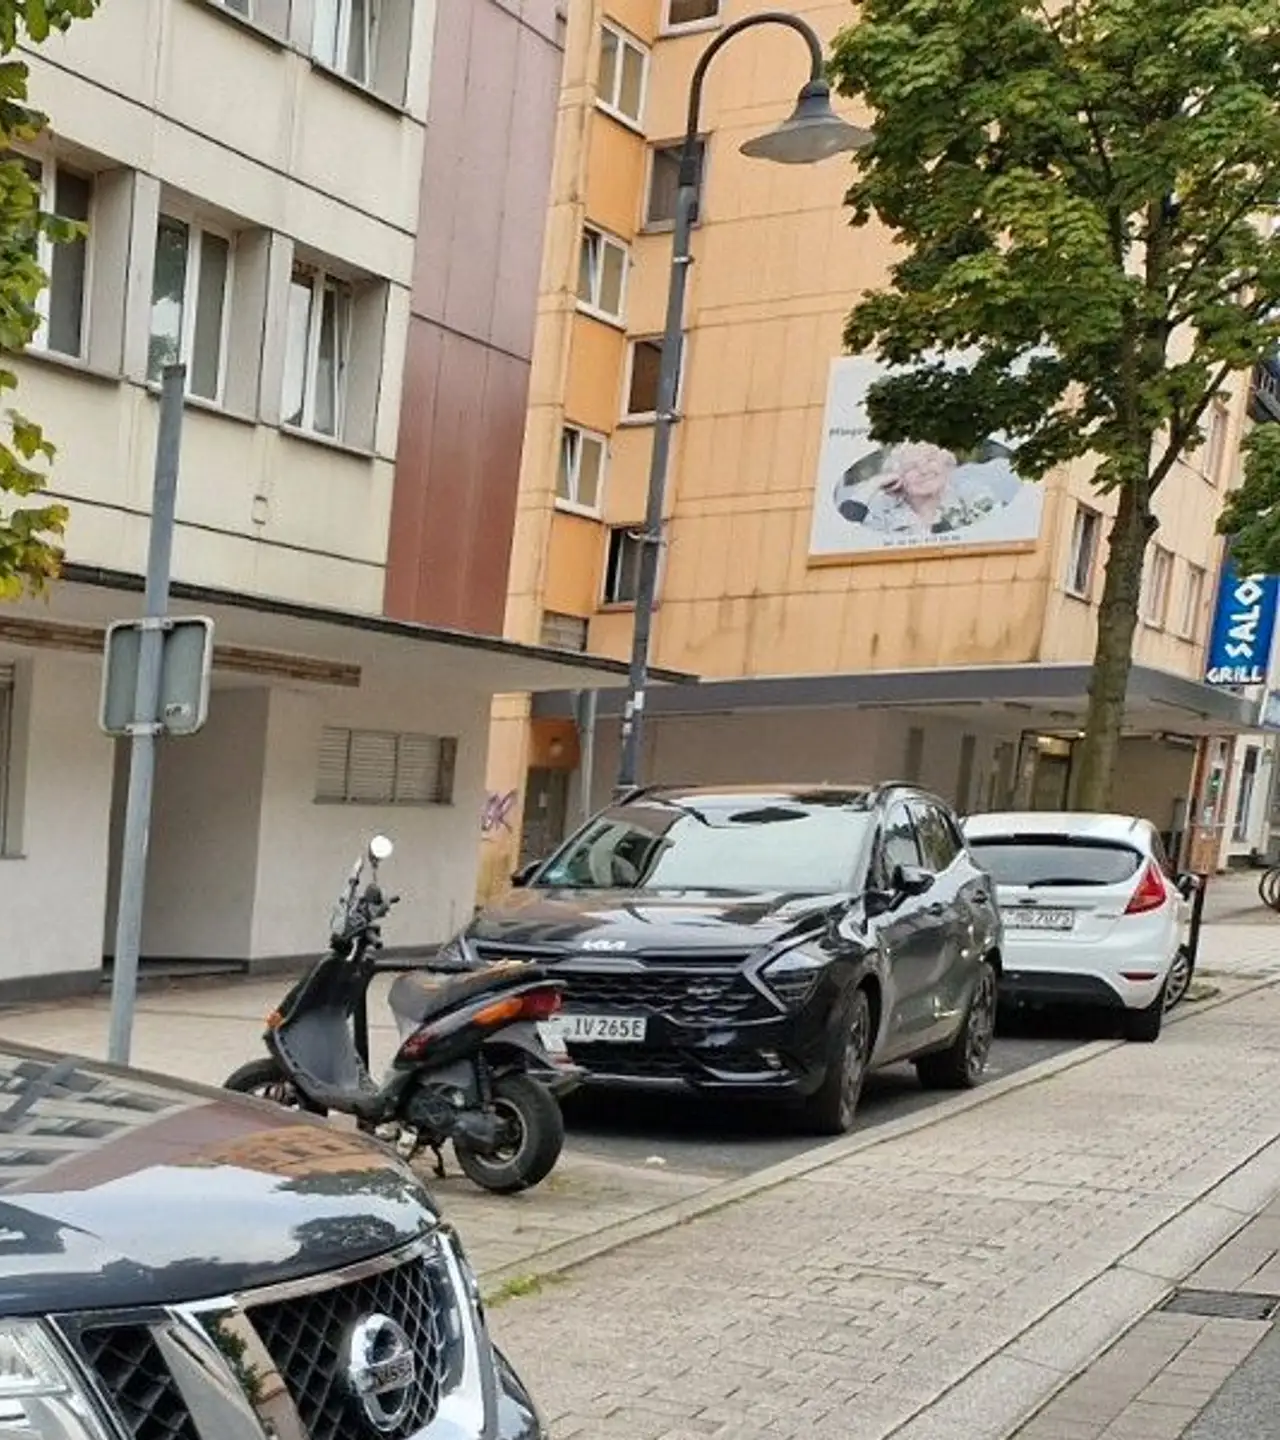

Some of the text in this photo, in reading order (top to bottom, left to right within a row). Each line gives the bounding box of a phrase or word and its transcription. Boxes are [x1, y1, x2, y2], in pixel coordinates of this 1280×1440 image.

[1223, 573, 1265, 660] SALO
[1206, 665, 1264, 684] GRILL
[597, 1019, 643, 1039] 265E
